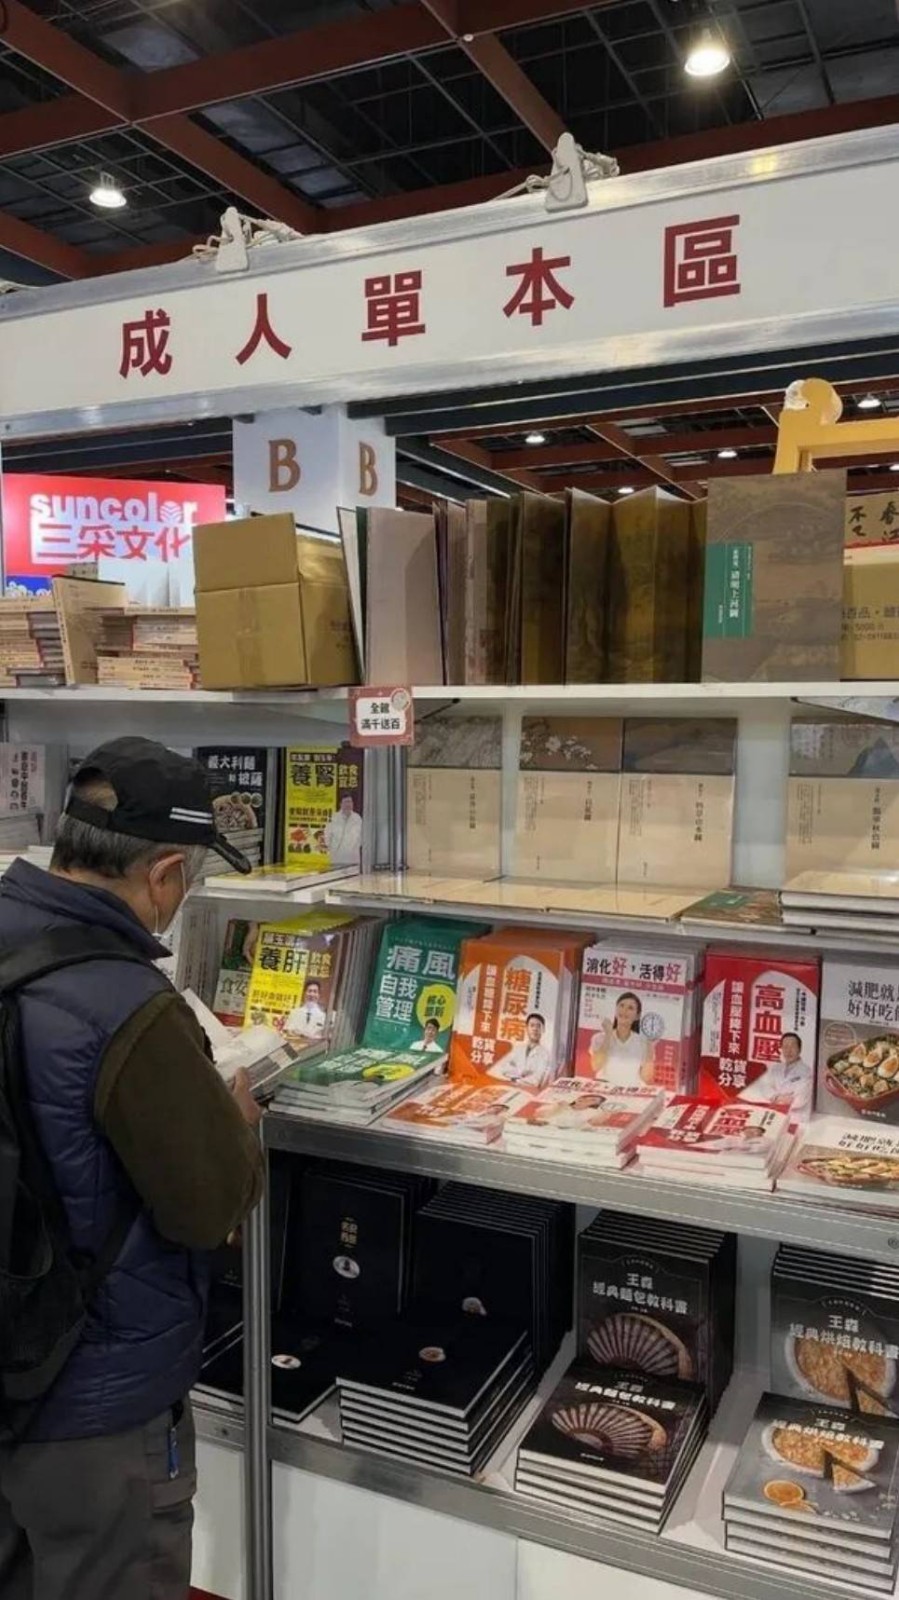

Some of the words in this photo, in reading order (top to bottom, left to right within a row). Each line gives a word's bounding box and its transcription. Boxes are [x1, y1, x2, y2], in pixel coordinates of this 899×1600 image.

[119, 214, 741, 379] 成人單本區
[268, 438, 301, 493] B
[358, 441, 379, 497] B
[30, 492, 198, 523] suncolor
[37, 523, 191, 562] 三采文化
[260, 947, 307, 975] 養肝
[387, 945, 455, 980] 痛風
[380, 974, 418, 999] 自我
[848, 980, 899, 1002] 減肥就
[376, 996, 414, 1022] 管理
[501, 967, 532, 1042] 糖尿病
[752, 984, 785, 1063] 高血壓
[470, 1050, 496, 1066] 分享
[718, 1073, 746, 1089] 分享
[592, 1281, 688, 1315] 經典麵包教科書
[790, 1322, 899, 1360] 經典烘焙教科書
